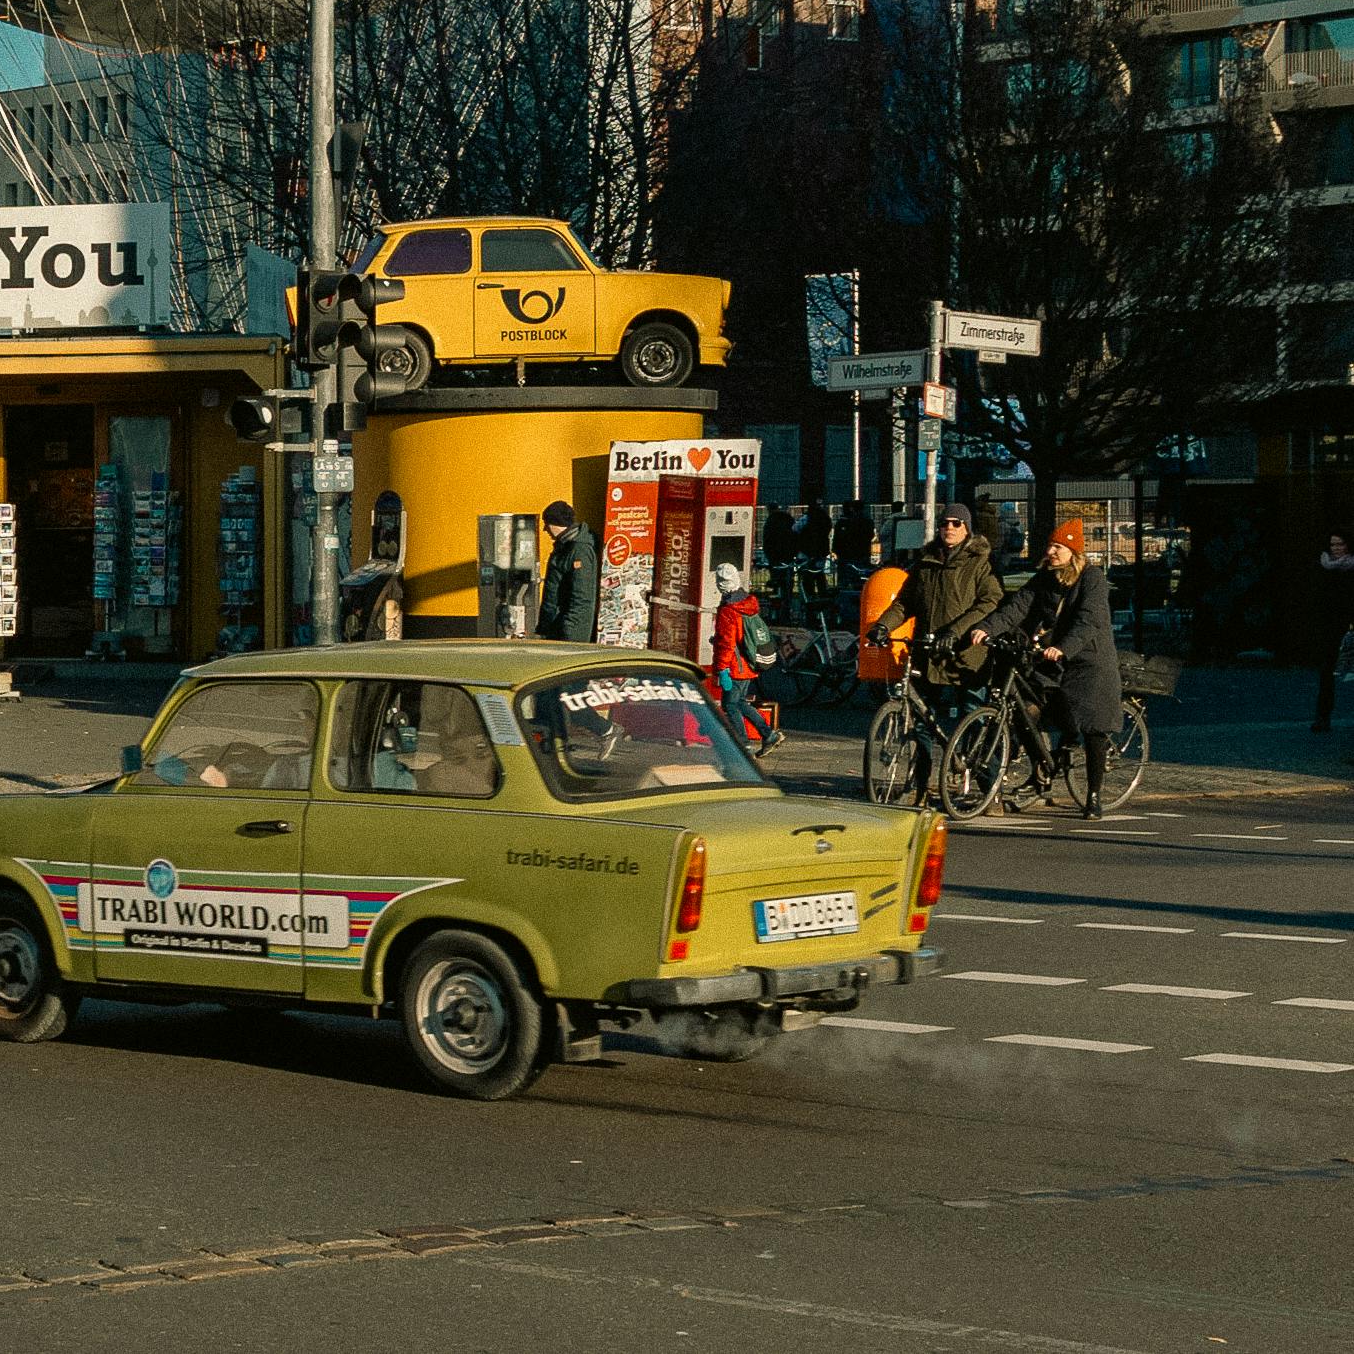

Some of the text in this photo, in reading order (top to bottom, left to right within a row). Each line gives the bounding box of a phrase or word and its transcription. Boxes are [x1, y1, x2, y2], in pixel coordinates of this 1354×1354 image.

[500, 328, 569, 342] POSTBLOCK
[960, 321, 1026, 346] Zimmerstraße
[841, 359, 913, 380] Wilhelmstraße
[613, 449, 757, 472] Berlin You
[558, 679, 706, 712] trabi-safari.de
[506, 848, 640, 876] trabi-safari.de
[97, 896, 329, 934] TRABI WORLD.com
[130, 933, 169, 948] Original
